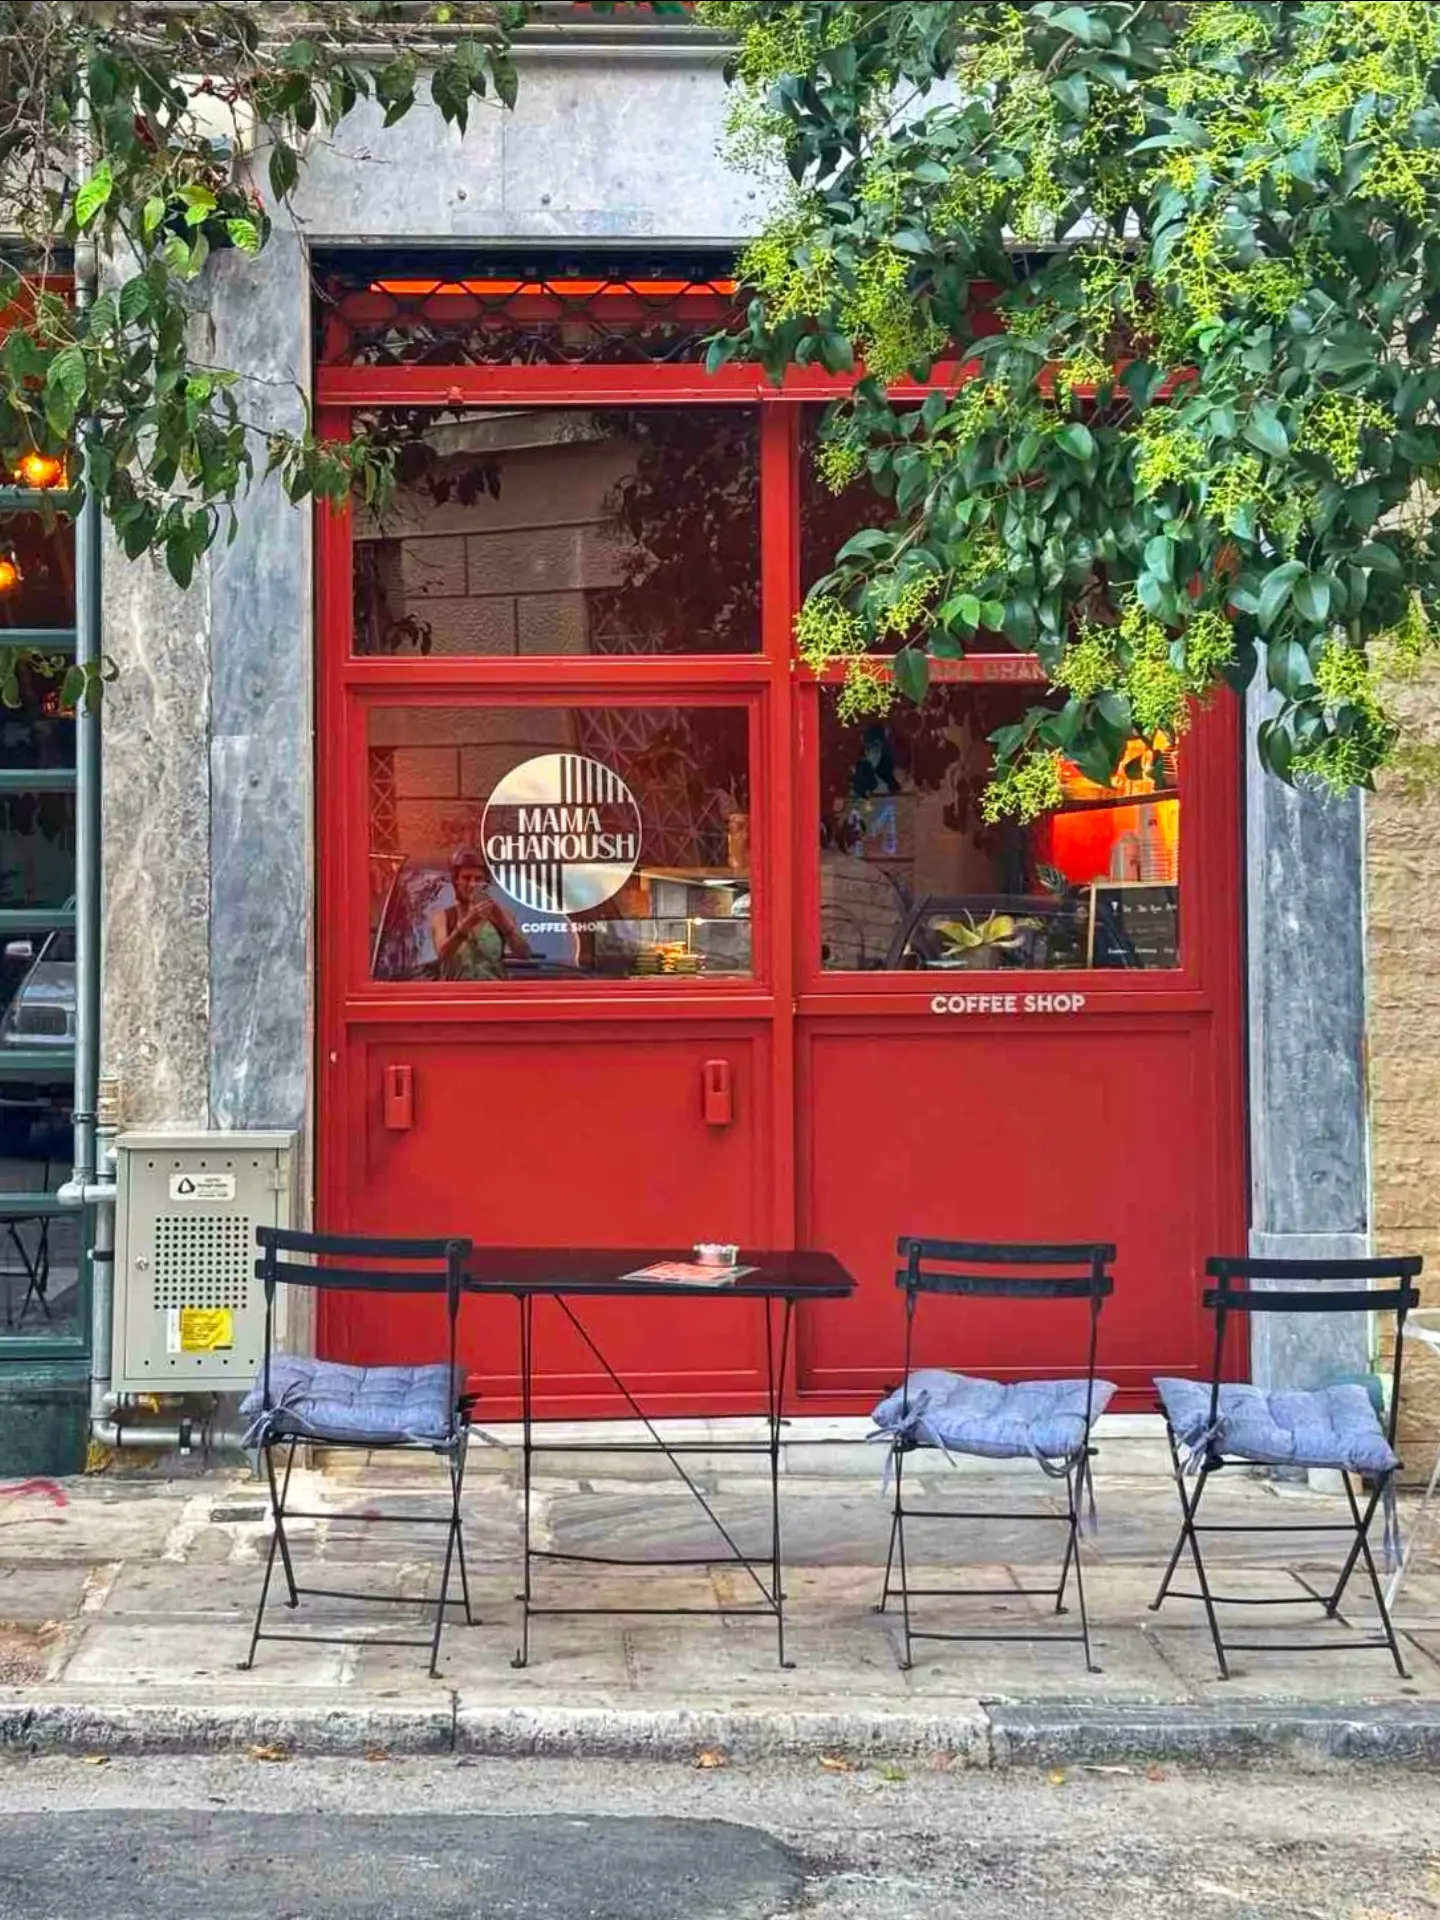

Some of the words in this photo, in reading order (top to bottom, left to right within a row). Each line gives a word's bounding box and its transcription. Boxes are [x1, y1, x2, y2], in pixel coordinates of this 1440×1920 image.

[518, 807, 602, 833] MAMA
[487, 833, 635, 861] GHANOUSH
[521, 922, 568, 933] COFFEE
[931, 995, 1017, 1014] COFFEE
[1023, 993, 1086, 1013] SHOP
